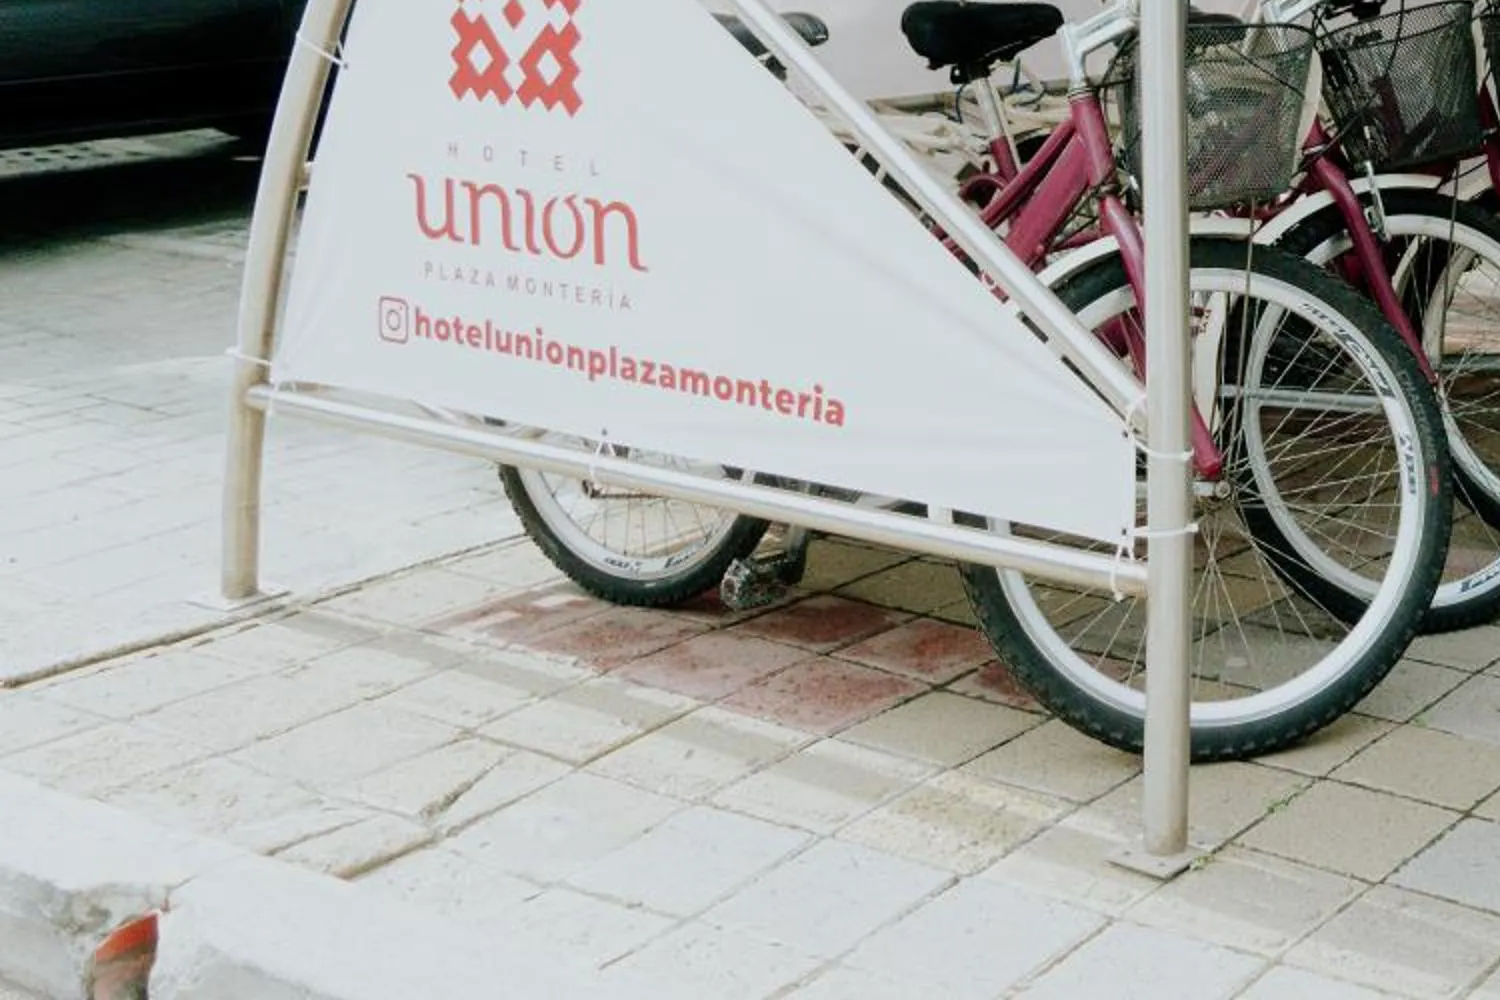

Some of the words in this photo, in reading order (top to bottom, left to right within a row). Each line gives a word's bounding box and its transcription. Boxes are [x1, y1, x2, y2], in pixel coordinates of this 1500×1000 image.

[447, 141, 601, 178] HOTEL
[423, 260, 497, 288] PLAZA
[505, 273, 633, 310] MONTERIA
[413, 305, 847, 428] hotelunionplazamonteria
